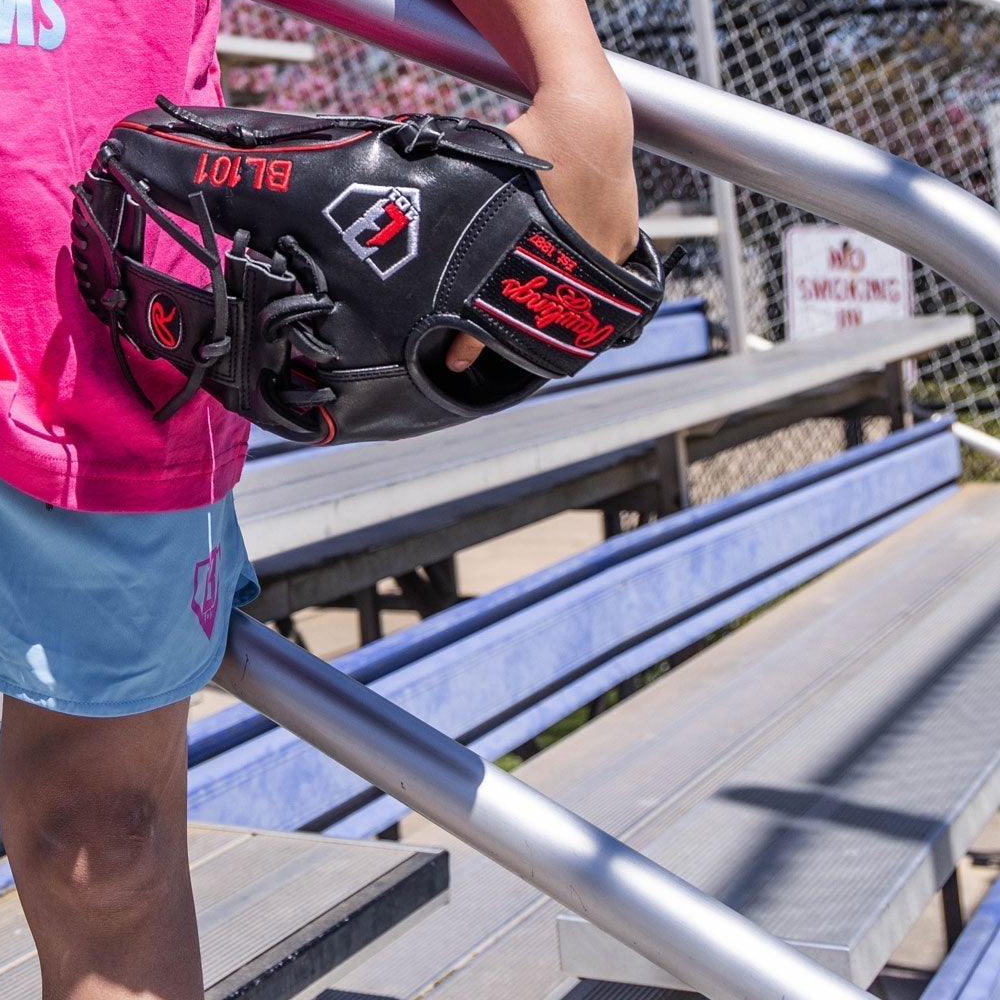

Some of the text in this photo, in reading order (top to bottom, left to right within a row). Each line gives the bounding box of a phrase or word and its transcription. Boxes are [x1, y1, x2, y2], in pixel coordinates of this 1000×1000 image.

[193, 153, 293, 192] BL101
[828, 248, 866, 273] NO
[501, 275, 615, 349] Rawlings
